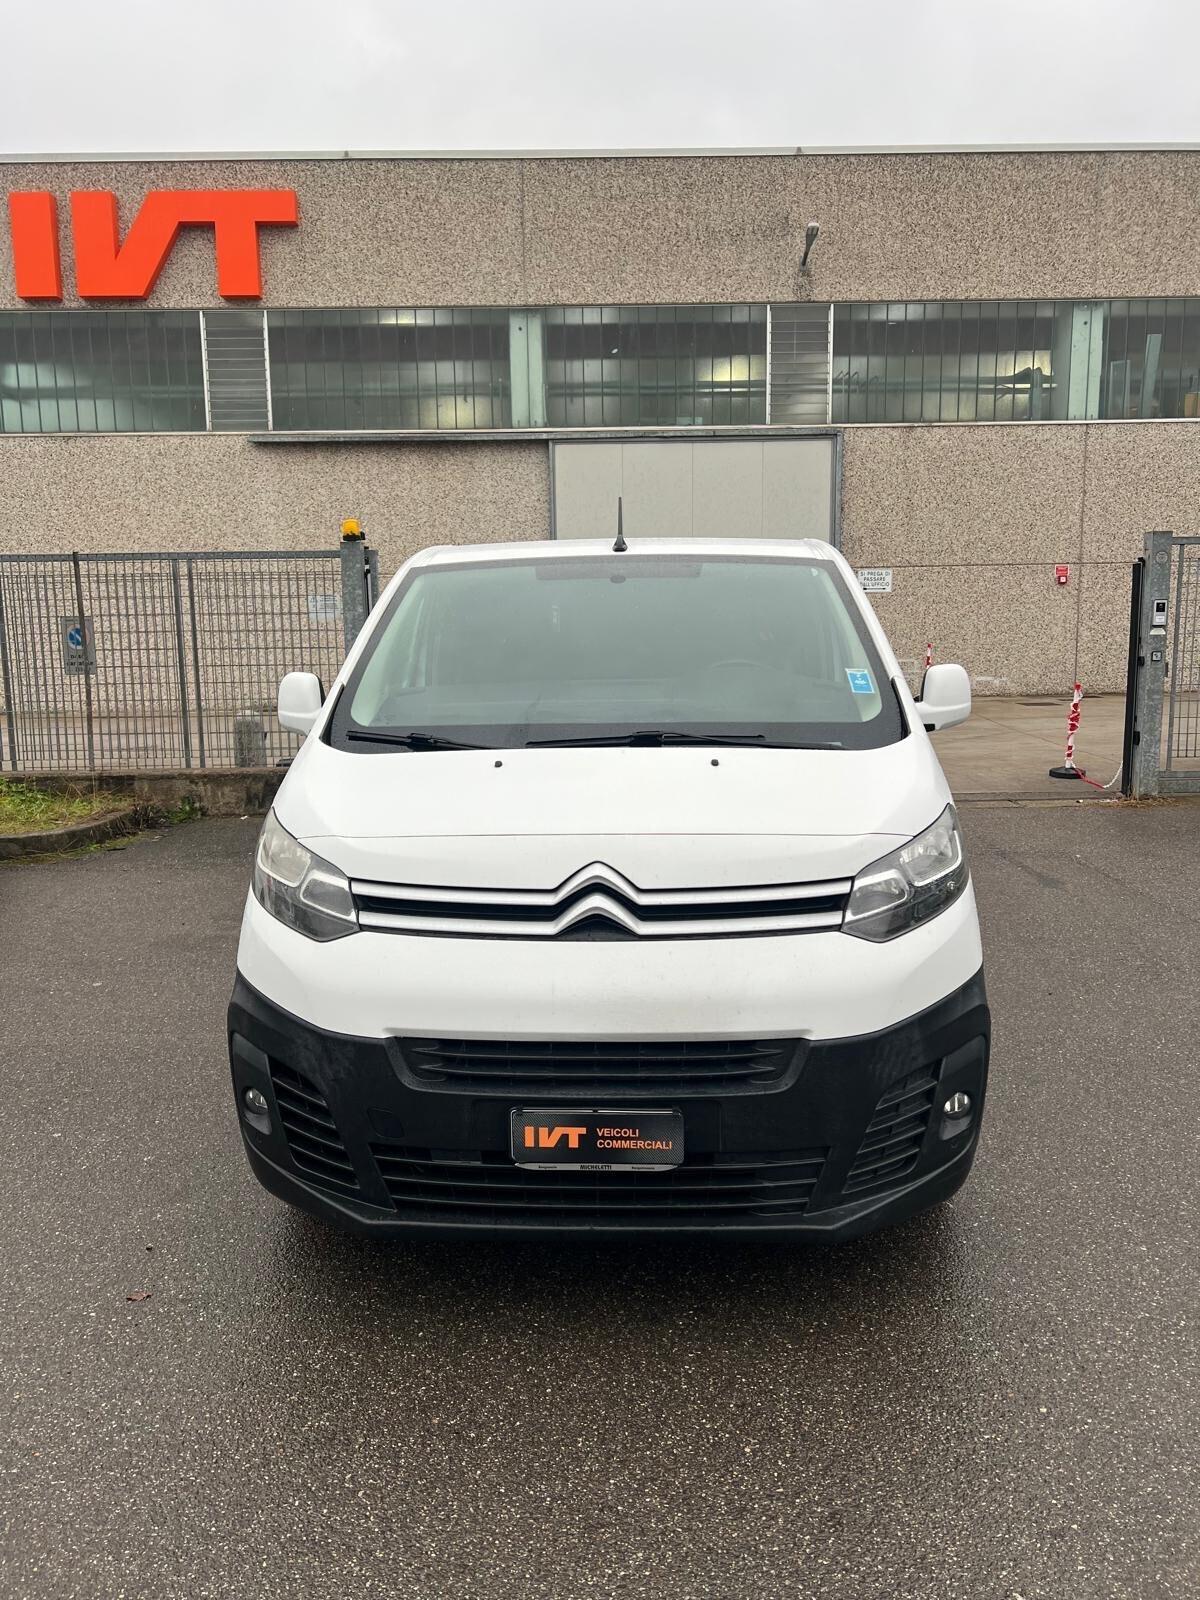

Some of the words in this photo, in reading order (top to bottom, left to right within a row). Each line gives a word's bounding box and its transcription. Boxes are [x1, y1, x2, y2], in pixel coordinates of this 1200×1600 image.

[8, 190, 299, 300] IVT
[524, 1126, 587, 1149] IVT
[596, 1127, 639, 1138] VEICOLI
[596, 1139, 673, 1150] COMMERCIALI
